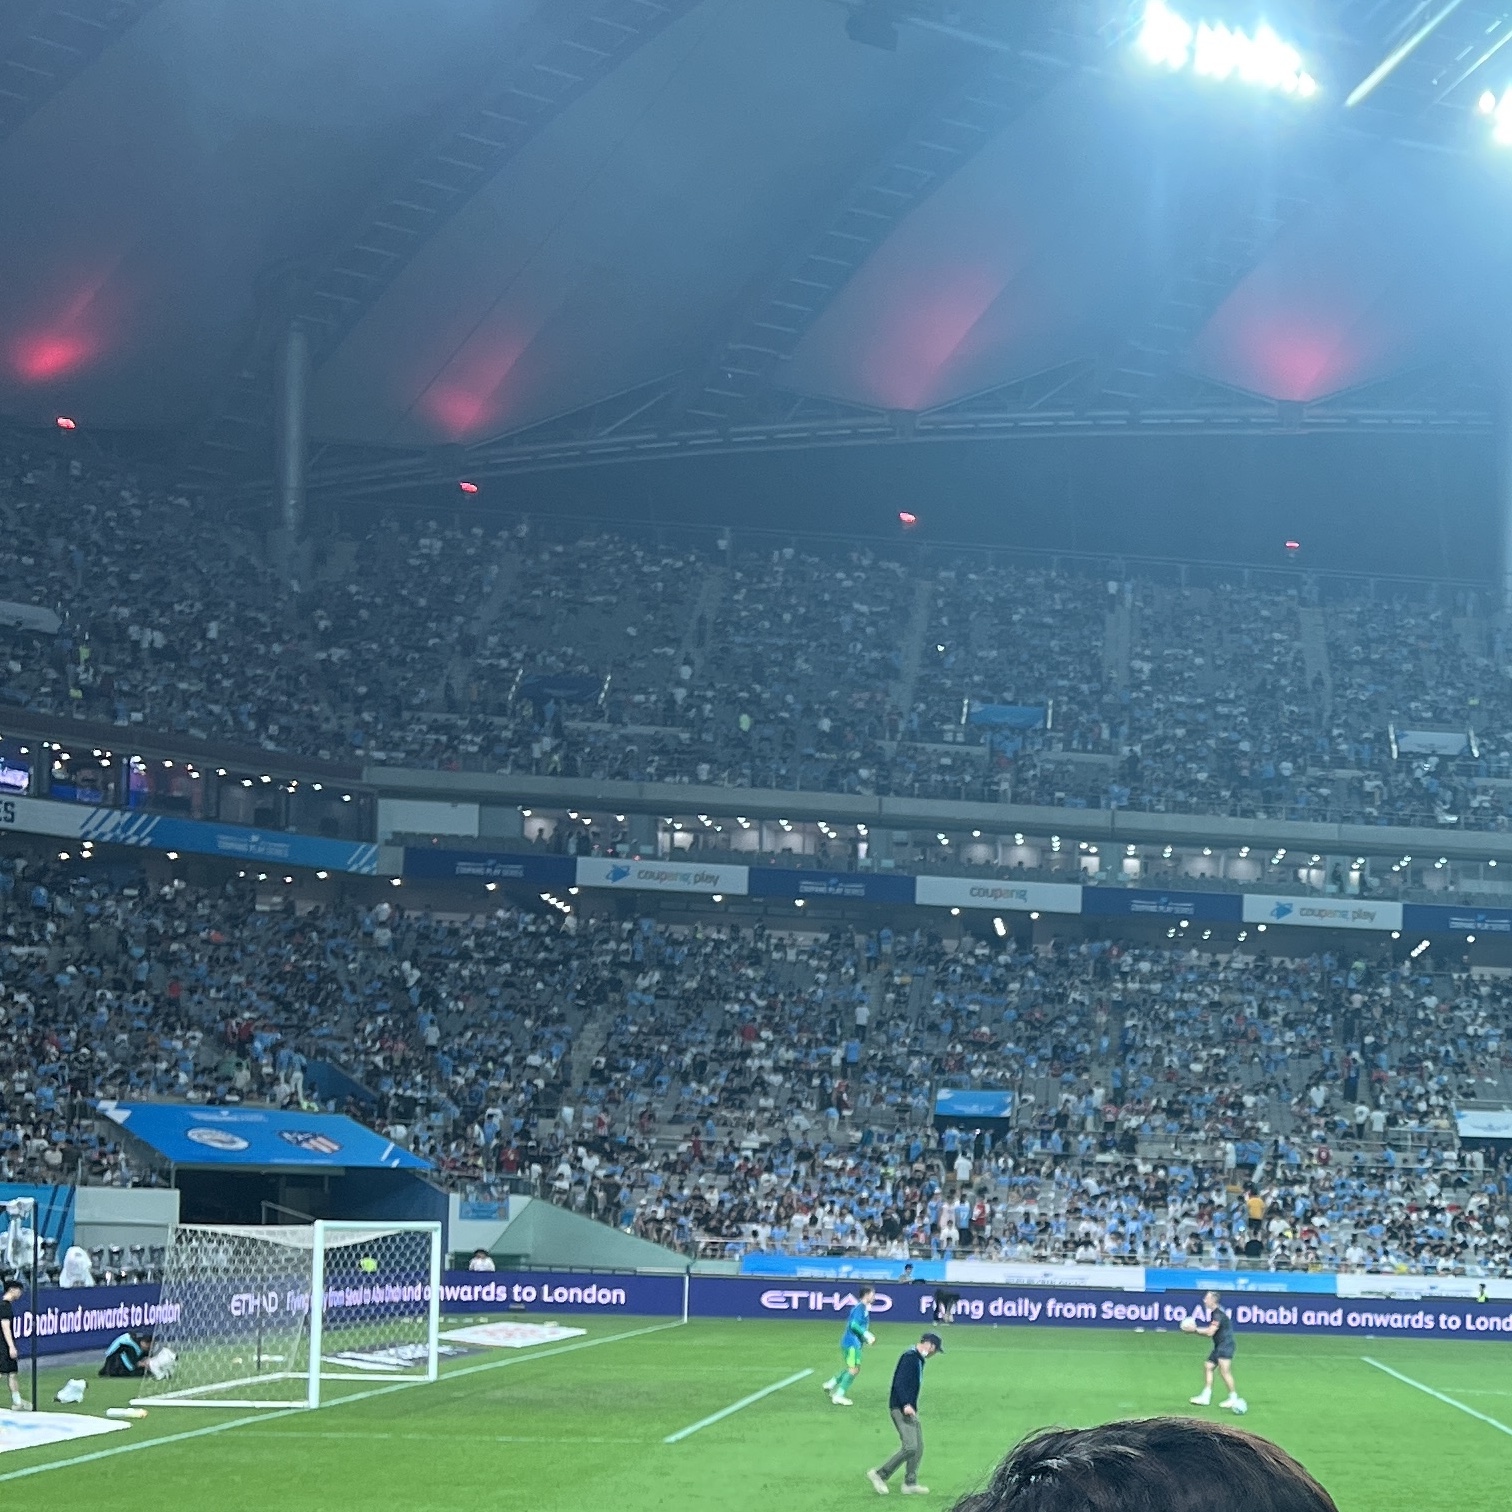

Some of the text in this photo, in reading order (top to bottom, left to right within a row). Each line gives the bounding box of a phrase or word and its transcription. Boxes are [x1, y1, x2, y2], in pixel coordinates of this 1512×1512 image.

[636, 868, 721, 888] coupang play
[969, 885, 1028, 903] coupang
[1299, 906, 1376, 924] coupang play
[512, 1283, 537, 1302] to
[543, 1284, 626, 1305] London
[760, 1290, 893, 1312] ETIHAD
[60, 1304, 82, 1333] and
[83, 1304, 129, 1332] onwards
[130, 1303, 142, 1327] to
[144, 1301, 181, 1326] London
[989, 1297, 1041, 1322] daily
[1046, 1298, 1097, 1319] from
[1101, 1300, 1160, 1321] Seoul
[1163, 1304, 1187, 1321] to
[1236, 1305, 1298, 1325] Dhabi
[1302, 1308, 1343, 1327] and
[1346, 1310, 1436, 1329] onwards
[1438, 1313, 1461, 1330] to
